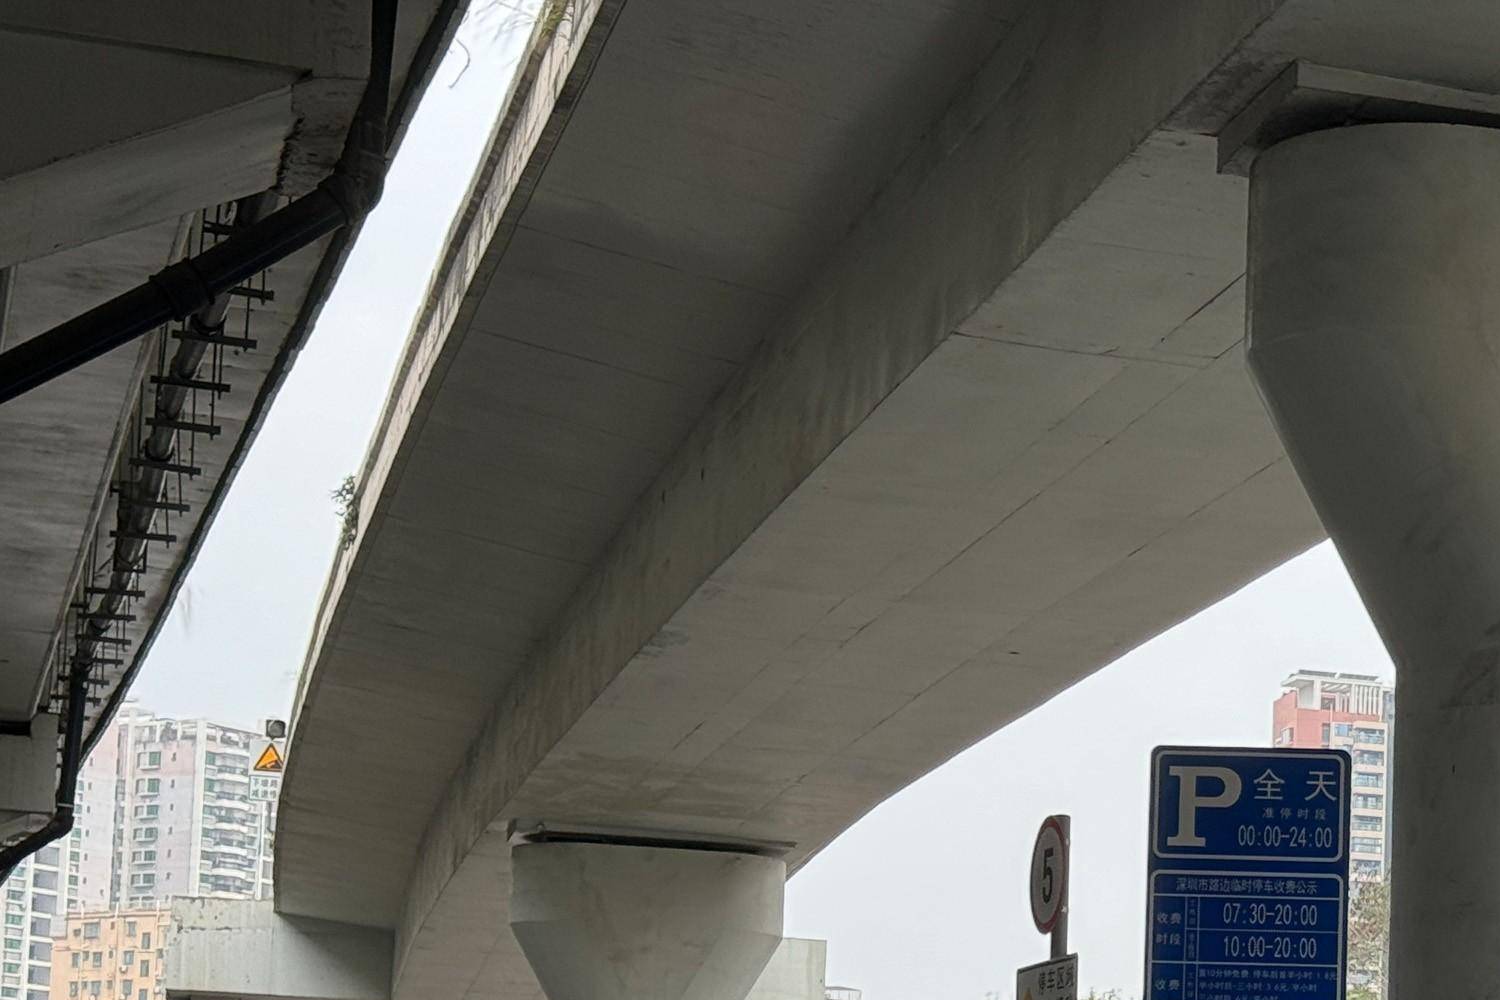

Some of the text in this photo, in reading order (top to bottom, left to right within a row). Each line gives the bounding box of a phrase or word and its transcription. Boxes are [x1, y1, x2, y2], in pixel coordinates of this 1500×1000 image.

[1253, 768, 1337, 801] 全天
[1167, 766, 1242, 847] P
[1238, 825, 1332, 848] 00:00-24:00
[1043, 847, 1054, 904] 5
[1223, 903, 1318, 926] 07:30-20:00
[1223, 936, 1317, 958] 10:00-20:00
